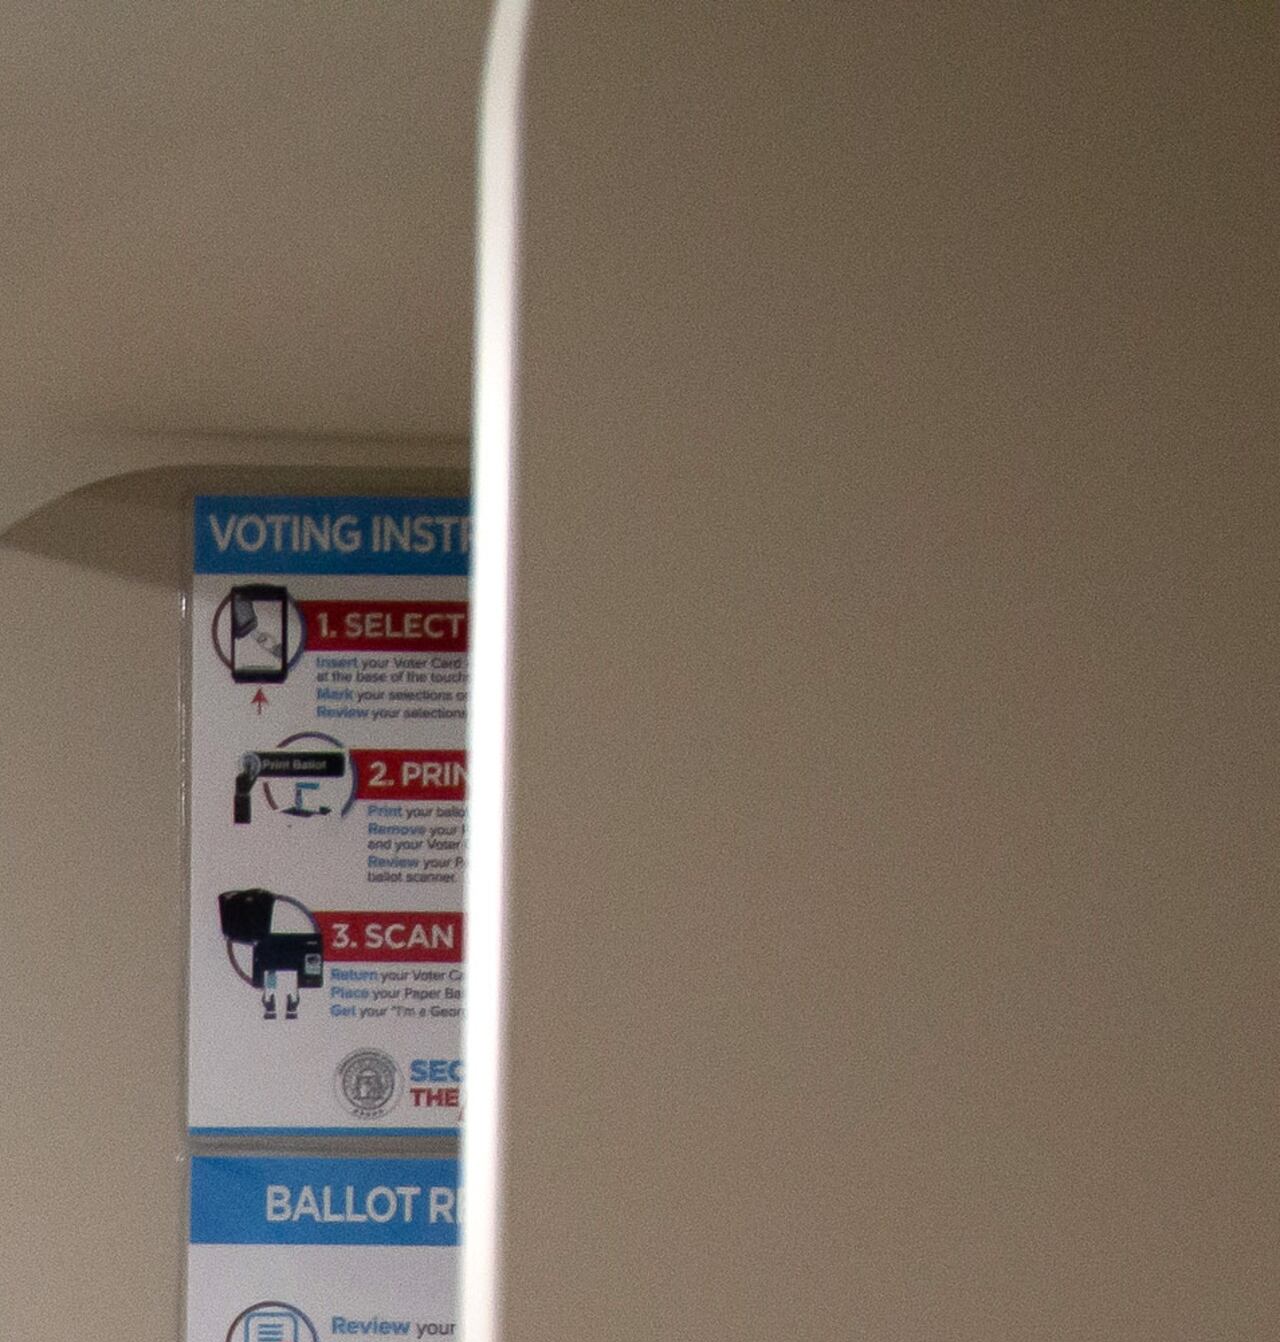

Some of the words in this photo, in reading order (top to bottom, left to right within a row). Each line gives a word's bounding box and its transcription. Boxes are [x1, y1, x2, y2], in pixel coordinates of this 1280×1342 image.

[209, 513, 361, 553] VOTING
[317, 613, 337, 638] 1.
[345, 613, 461, 640] SELECT
[368, 761, 395, 787] 2.
[331, 922, 358, 949] 3.
[364, 922, 455, 950] SCAN
[409, 1087, 460, 1108] THE
[265, 1184, 422, 1224] BALLOT
[330, 1316, 411, 1335] Review
[416, 1322, 456, 1340] your
